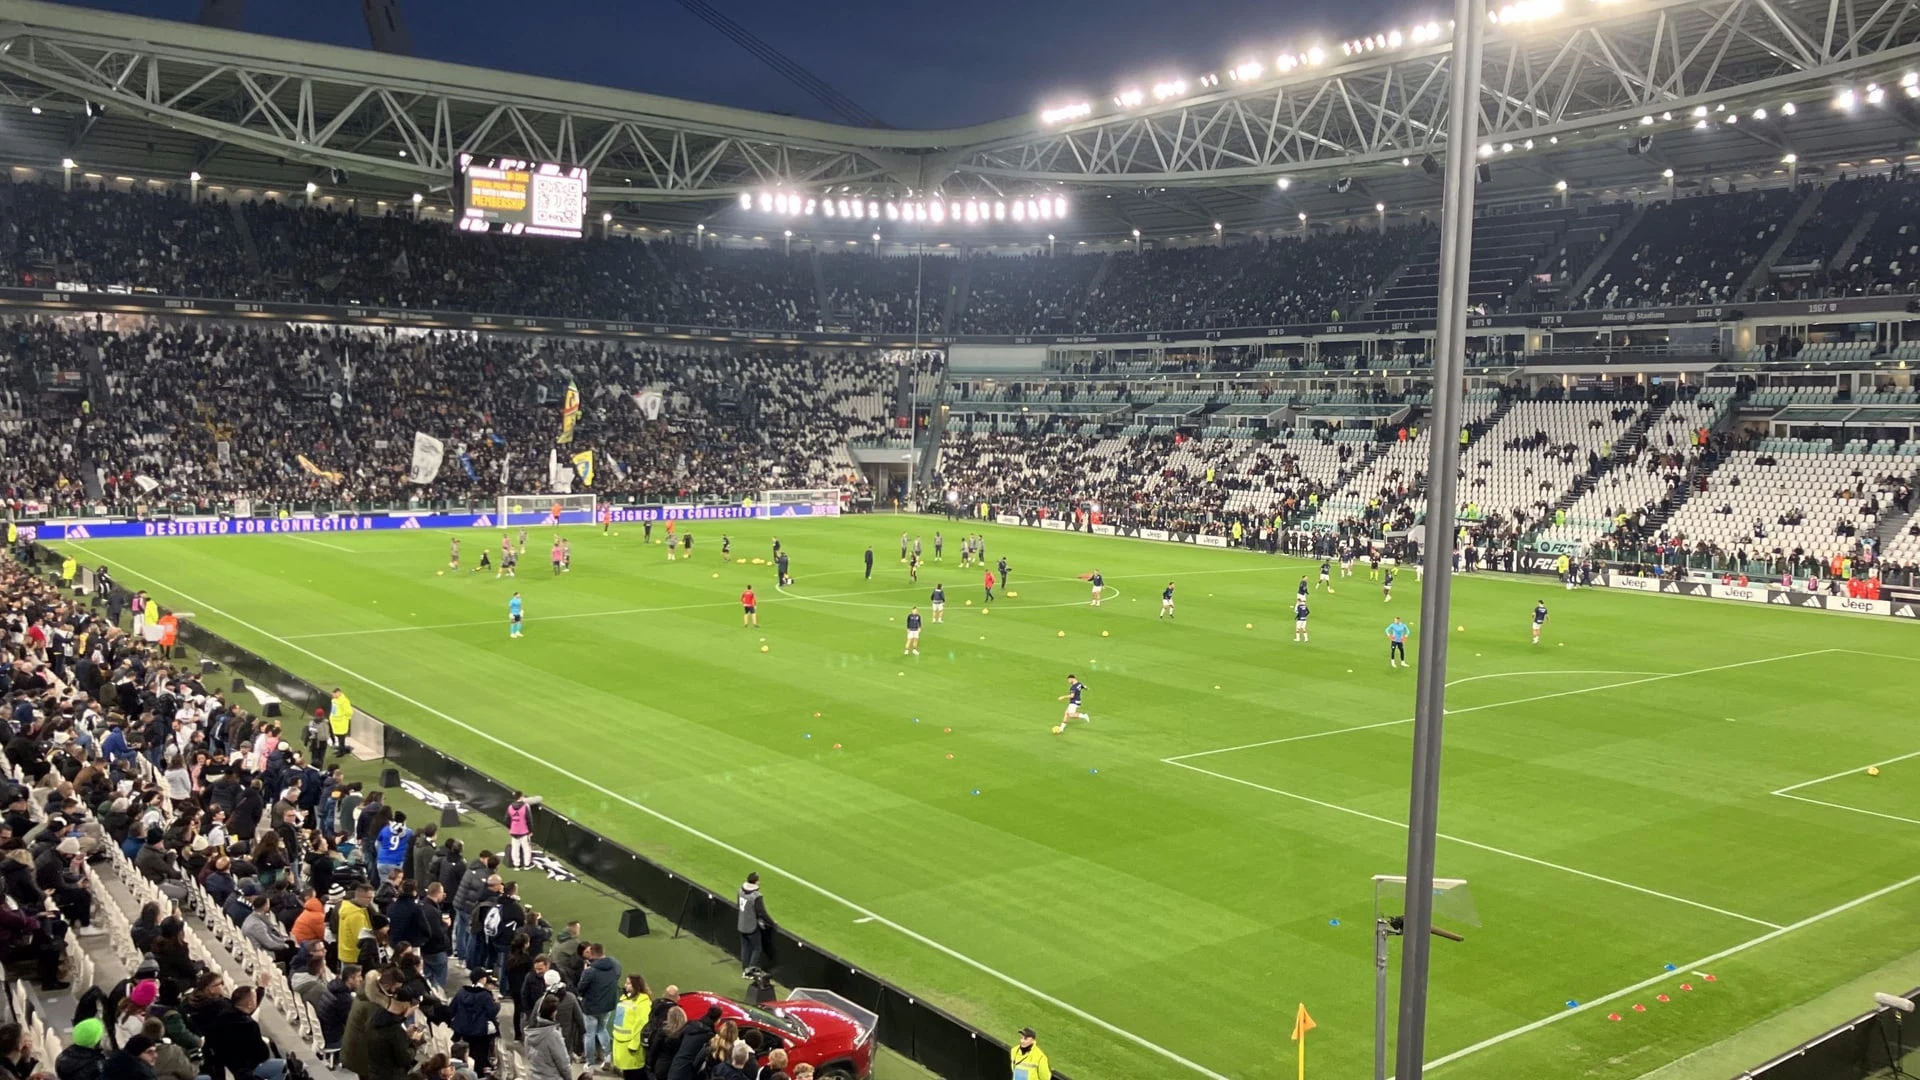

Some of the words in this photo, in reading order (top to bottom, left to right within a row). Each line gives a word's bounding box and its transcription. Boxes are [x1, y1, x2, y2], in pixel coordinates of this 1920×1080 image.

[1602, 313, 1626, 321] Allianz
[1636, 311, 1665, 320] Stadium
[662, 508, 685, 520] FOR
[687, 505, 761, 519] CONNECTION
[145, 521, 229, 536] DESIGNED
[236, 520, 266, 533] FOR
[270, 517, 372, 532] CONNECTION
[1147, 531, 1162, 539] Jeep
[1203, 537, 1220, 545] Jeep
[1533, 557, 1557, 570] FC2
[1622, 576, 1648, 589] Jeep
[1725, 587, 1754, 600] Jeep
[1841, 599, 1874, 612] Jeep
[390, 835, 400, 851] 9
